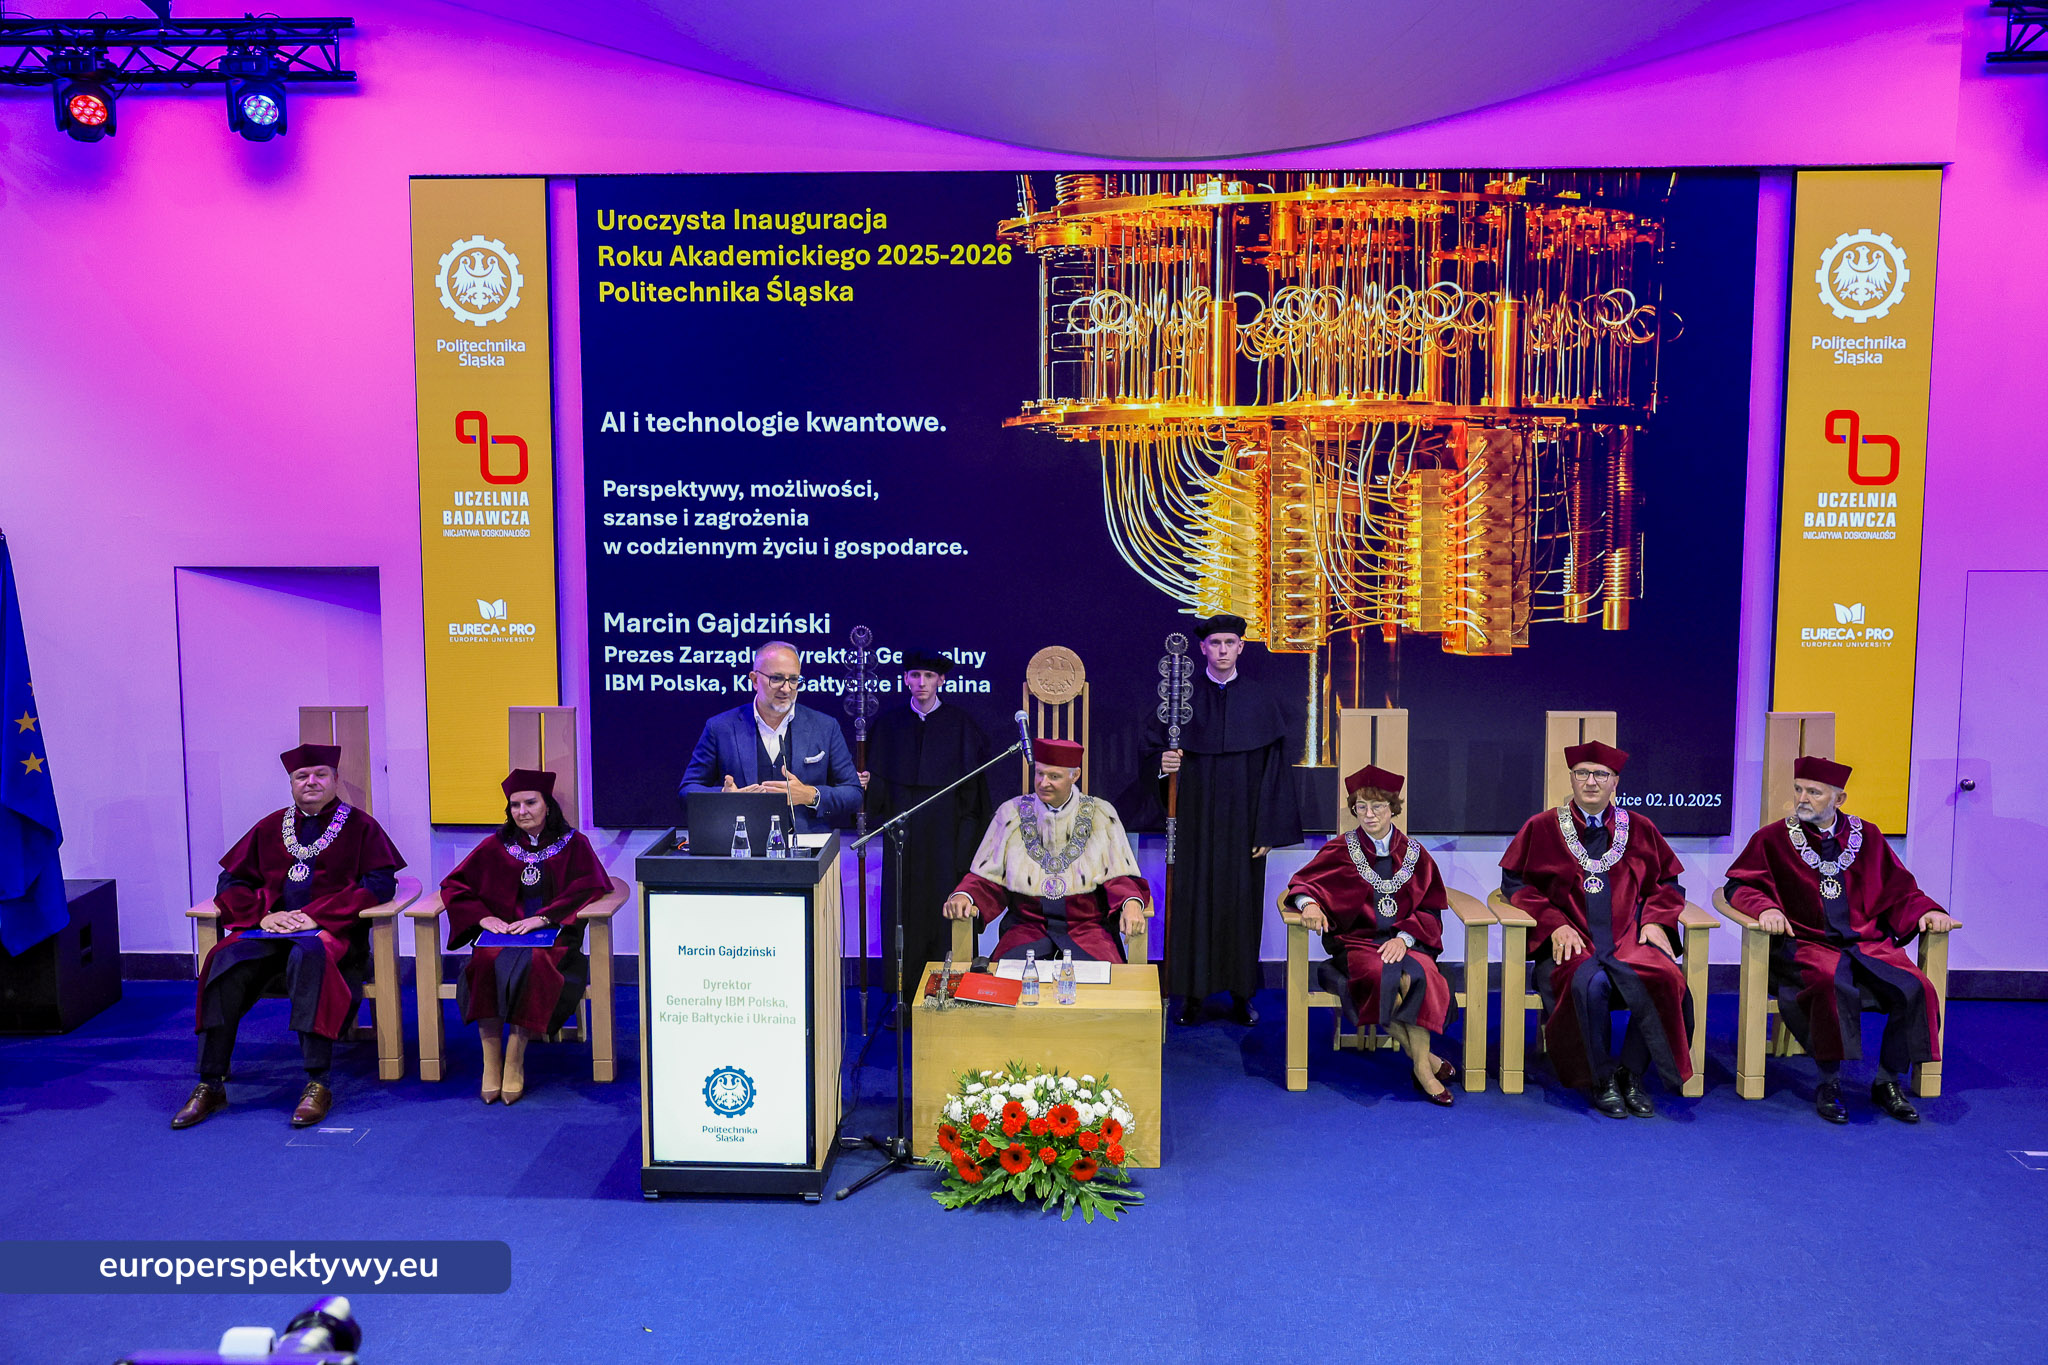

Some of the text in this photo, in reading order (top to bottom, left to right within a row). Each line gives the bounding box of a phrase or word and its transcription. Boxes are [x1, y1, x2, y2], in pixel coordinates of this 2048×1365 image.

[597, 207, 887, 235] Uroczysta Inauguracja
[598, 243, 1013, 271] Roku Akademickiego 2025-2026
[599, 274, 854, 307] Politechnika Śląska
[437, 339, 526, 352] Politechnika
[1812, 335, 1907, 351] Politechnika
[459, 352, 505, 368] Śląska
[1833, 348, 1883, 366] Śląska
[600, 410, 947, 437] AI i technologie kwantowe.
[453, 490, 530, 507] UCZELNIA
[603, 479, 879, 502] Perspektywy, możliwości,
[1817, 492, 1898, 508] UCZELNIA
[442, 509, 531, 526] BADAWCZA
[603, 508, 809, 531] szanse i zagrożenia
[1803, 511, 1897, 528] BADAWCZA
[442, 528, 481, 538] INICJATYWA
[1802, 530, 1843, 540] INICJATYWA
[603, 536, 969, 560] w codziennym życiu i gospodarce.
[448, 622, 537, 636] EURECA PRO
[603, 612, 830, 638] Marcin Gajdziński
[1800, 627, 1895, 641] EURECA PRO
[604, 645, 674, 664] Prezes
[605, 673, 644, 692] IBM
[650, 674, 727, 695] Polska,
[897, 674, 903, 693] i
[1645, 793, 1722, 807] 02.10.2025
[678, 944, 776, 960] Marcin Gajdziński
[703, 978, 752, 993] Dyrektor
[666, 994, 788, 1009] Generalny IBM Polska,
[659, 1011, 689, 1025] Kraje
[691, 1011, 744, 1026] Bałtyckie
[752, 1013, 796, 1025] Ukraina
[702, 1125, 758, 1134] Politechnika
